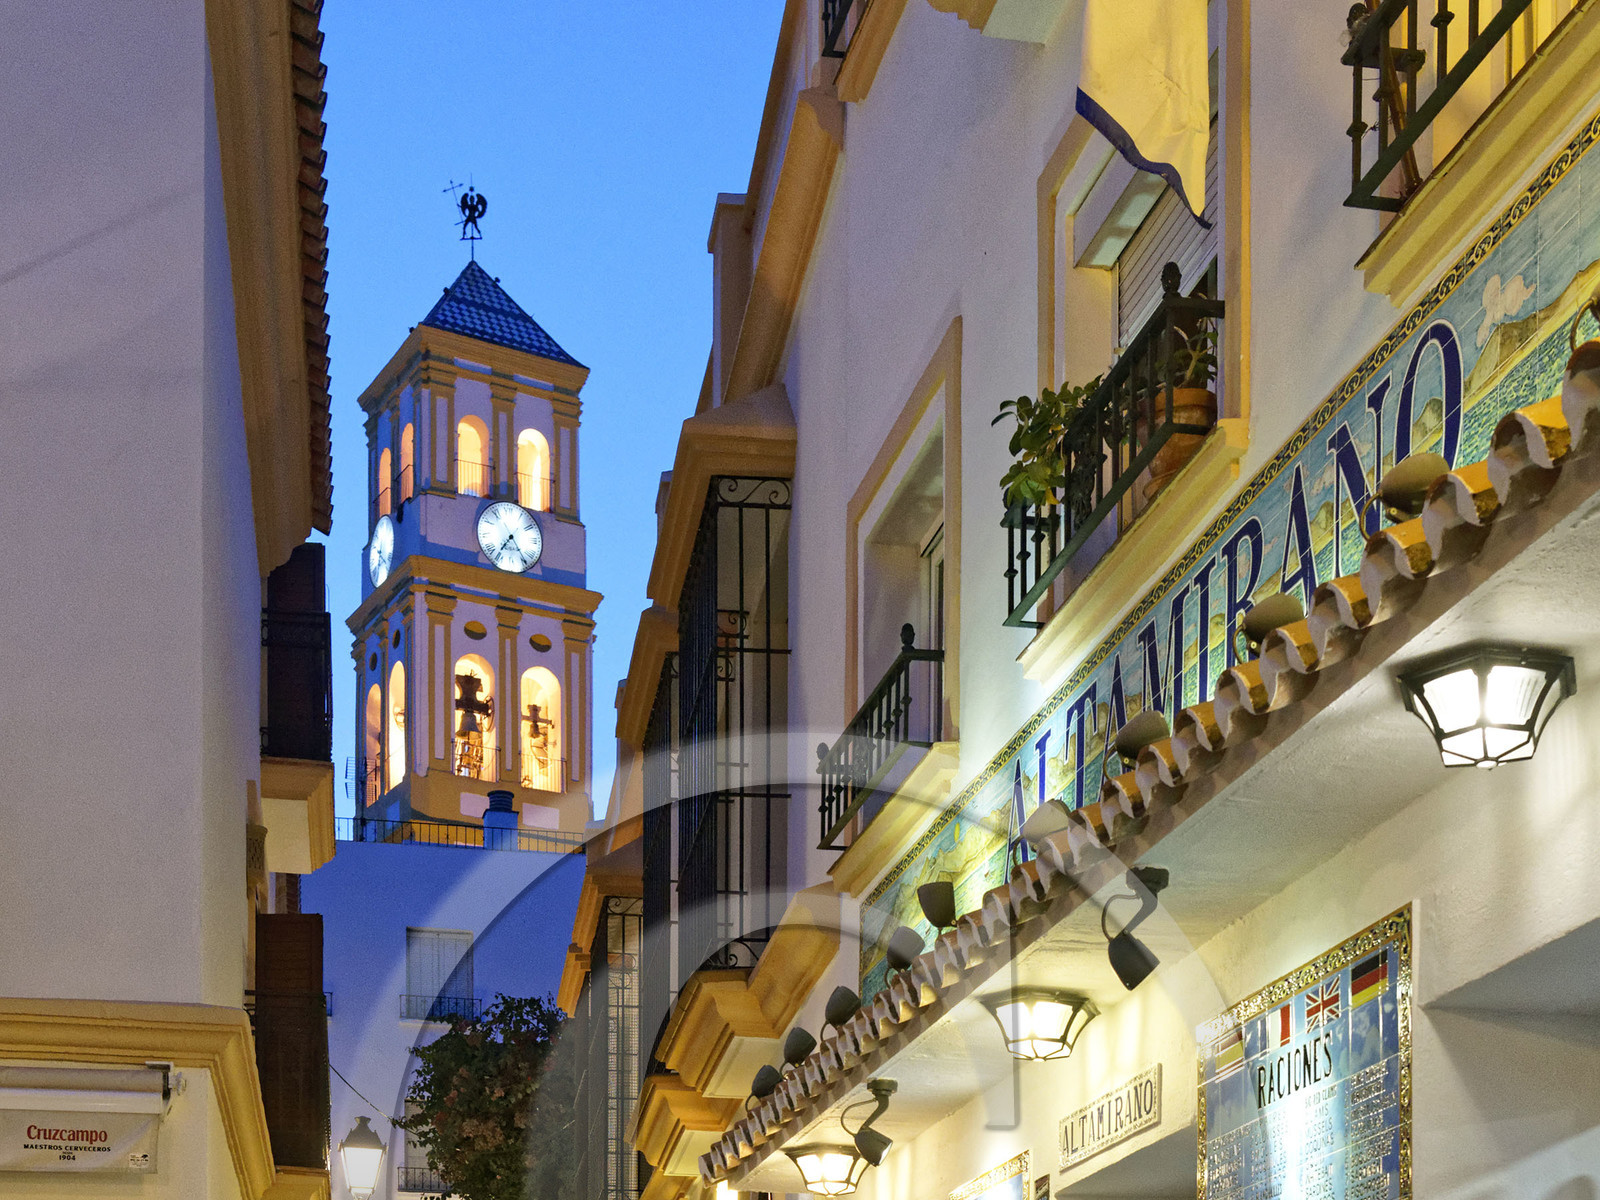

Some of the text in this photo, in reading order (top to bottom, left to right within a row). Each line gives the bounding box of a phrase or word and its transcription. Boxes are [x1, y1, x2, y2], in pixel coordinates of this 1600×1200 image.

[1004, 317, 1464, 885] ALTAMIRANO
[1257, 1032, 1333, 1111] RACIONES
[23, 1143, 63, 1151] MAESTROS
[26, 1124, 108, 1145] Cruzcampo
[1062, 1078, 1154, 1158] ALTAMIRANO
